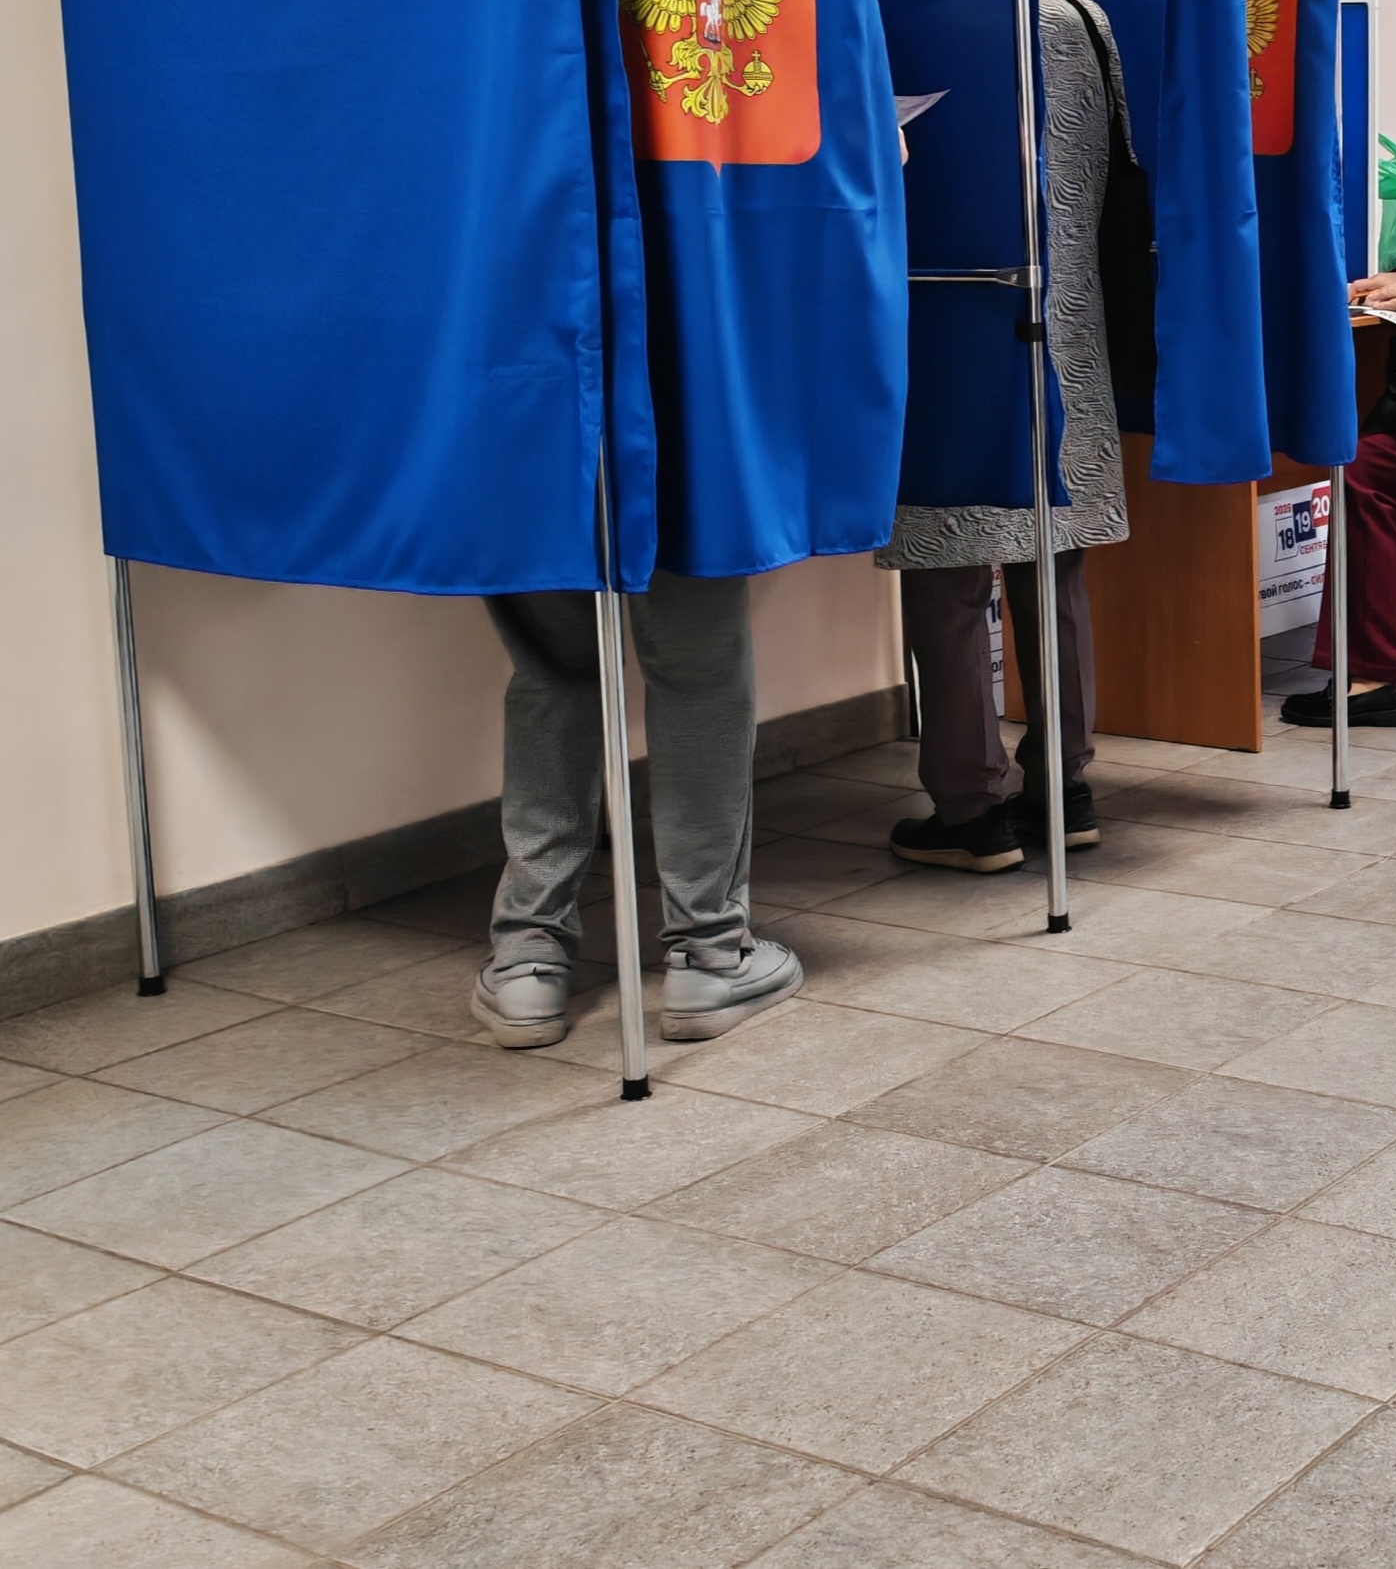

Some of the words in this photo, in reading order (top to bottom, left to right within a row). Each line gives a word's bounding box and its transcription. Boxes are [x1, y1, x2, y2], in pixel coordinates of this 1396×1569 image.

[1278, 528, 1295, 550] 18
[1295, 511, 1311, 534] 19
[1312, 495, 1330, 519] 20
[1278, 579, 1304, 595] ГОЛОС
